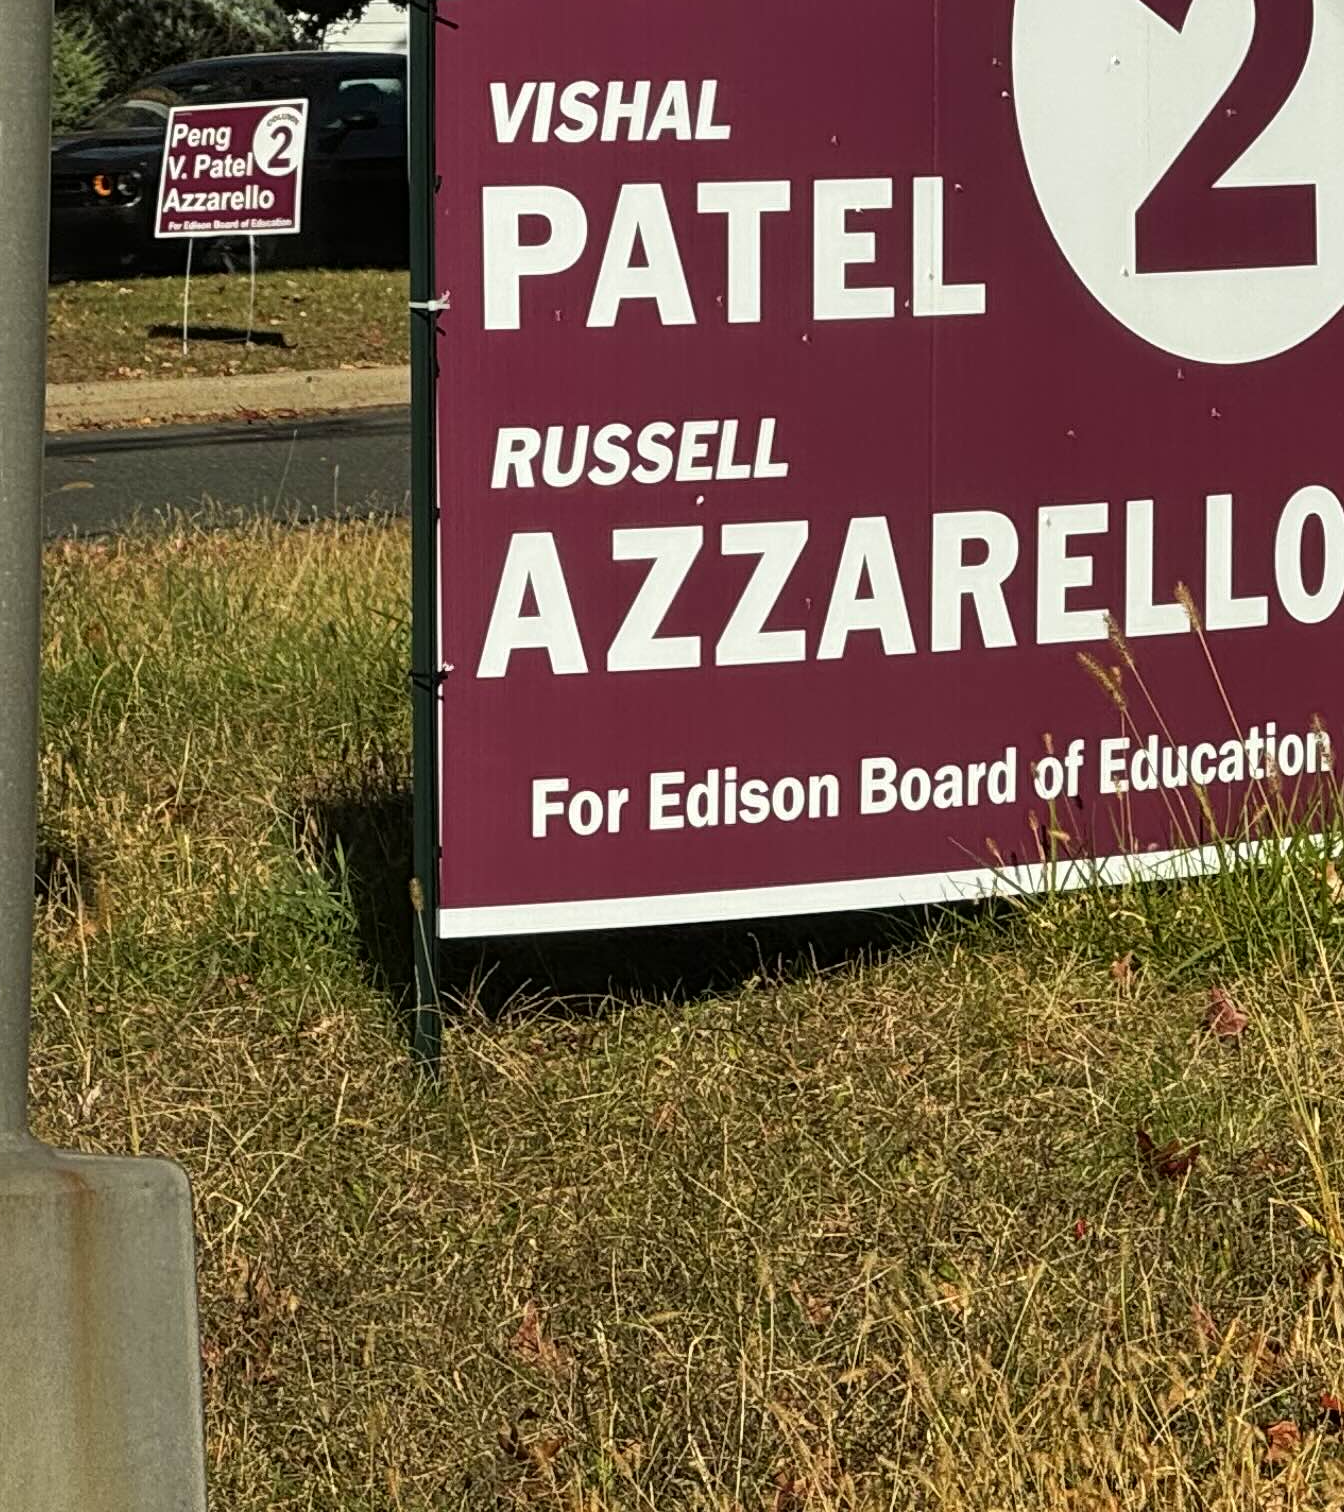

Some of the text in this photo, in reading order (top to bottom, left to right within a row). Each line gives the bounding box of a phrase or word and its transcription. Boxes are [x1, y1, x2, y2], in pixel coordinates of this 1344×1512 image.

[171, 123, 232, 152] Peng
[489, 79, 732, 143] VISHAL
[168, 152, 253, 181] V. Patel
[267, 125, 293, 169] 2
[162, 184, 276, 214] Azzarello
[482, 176, 987, 331] PATEL
[490, 417, 789, 489] RUSSELL
[532, 721, 1332, 838] For Edison Board of Education
